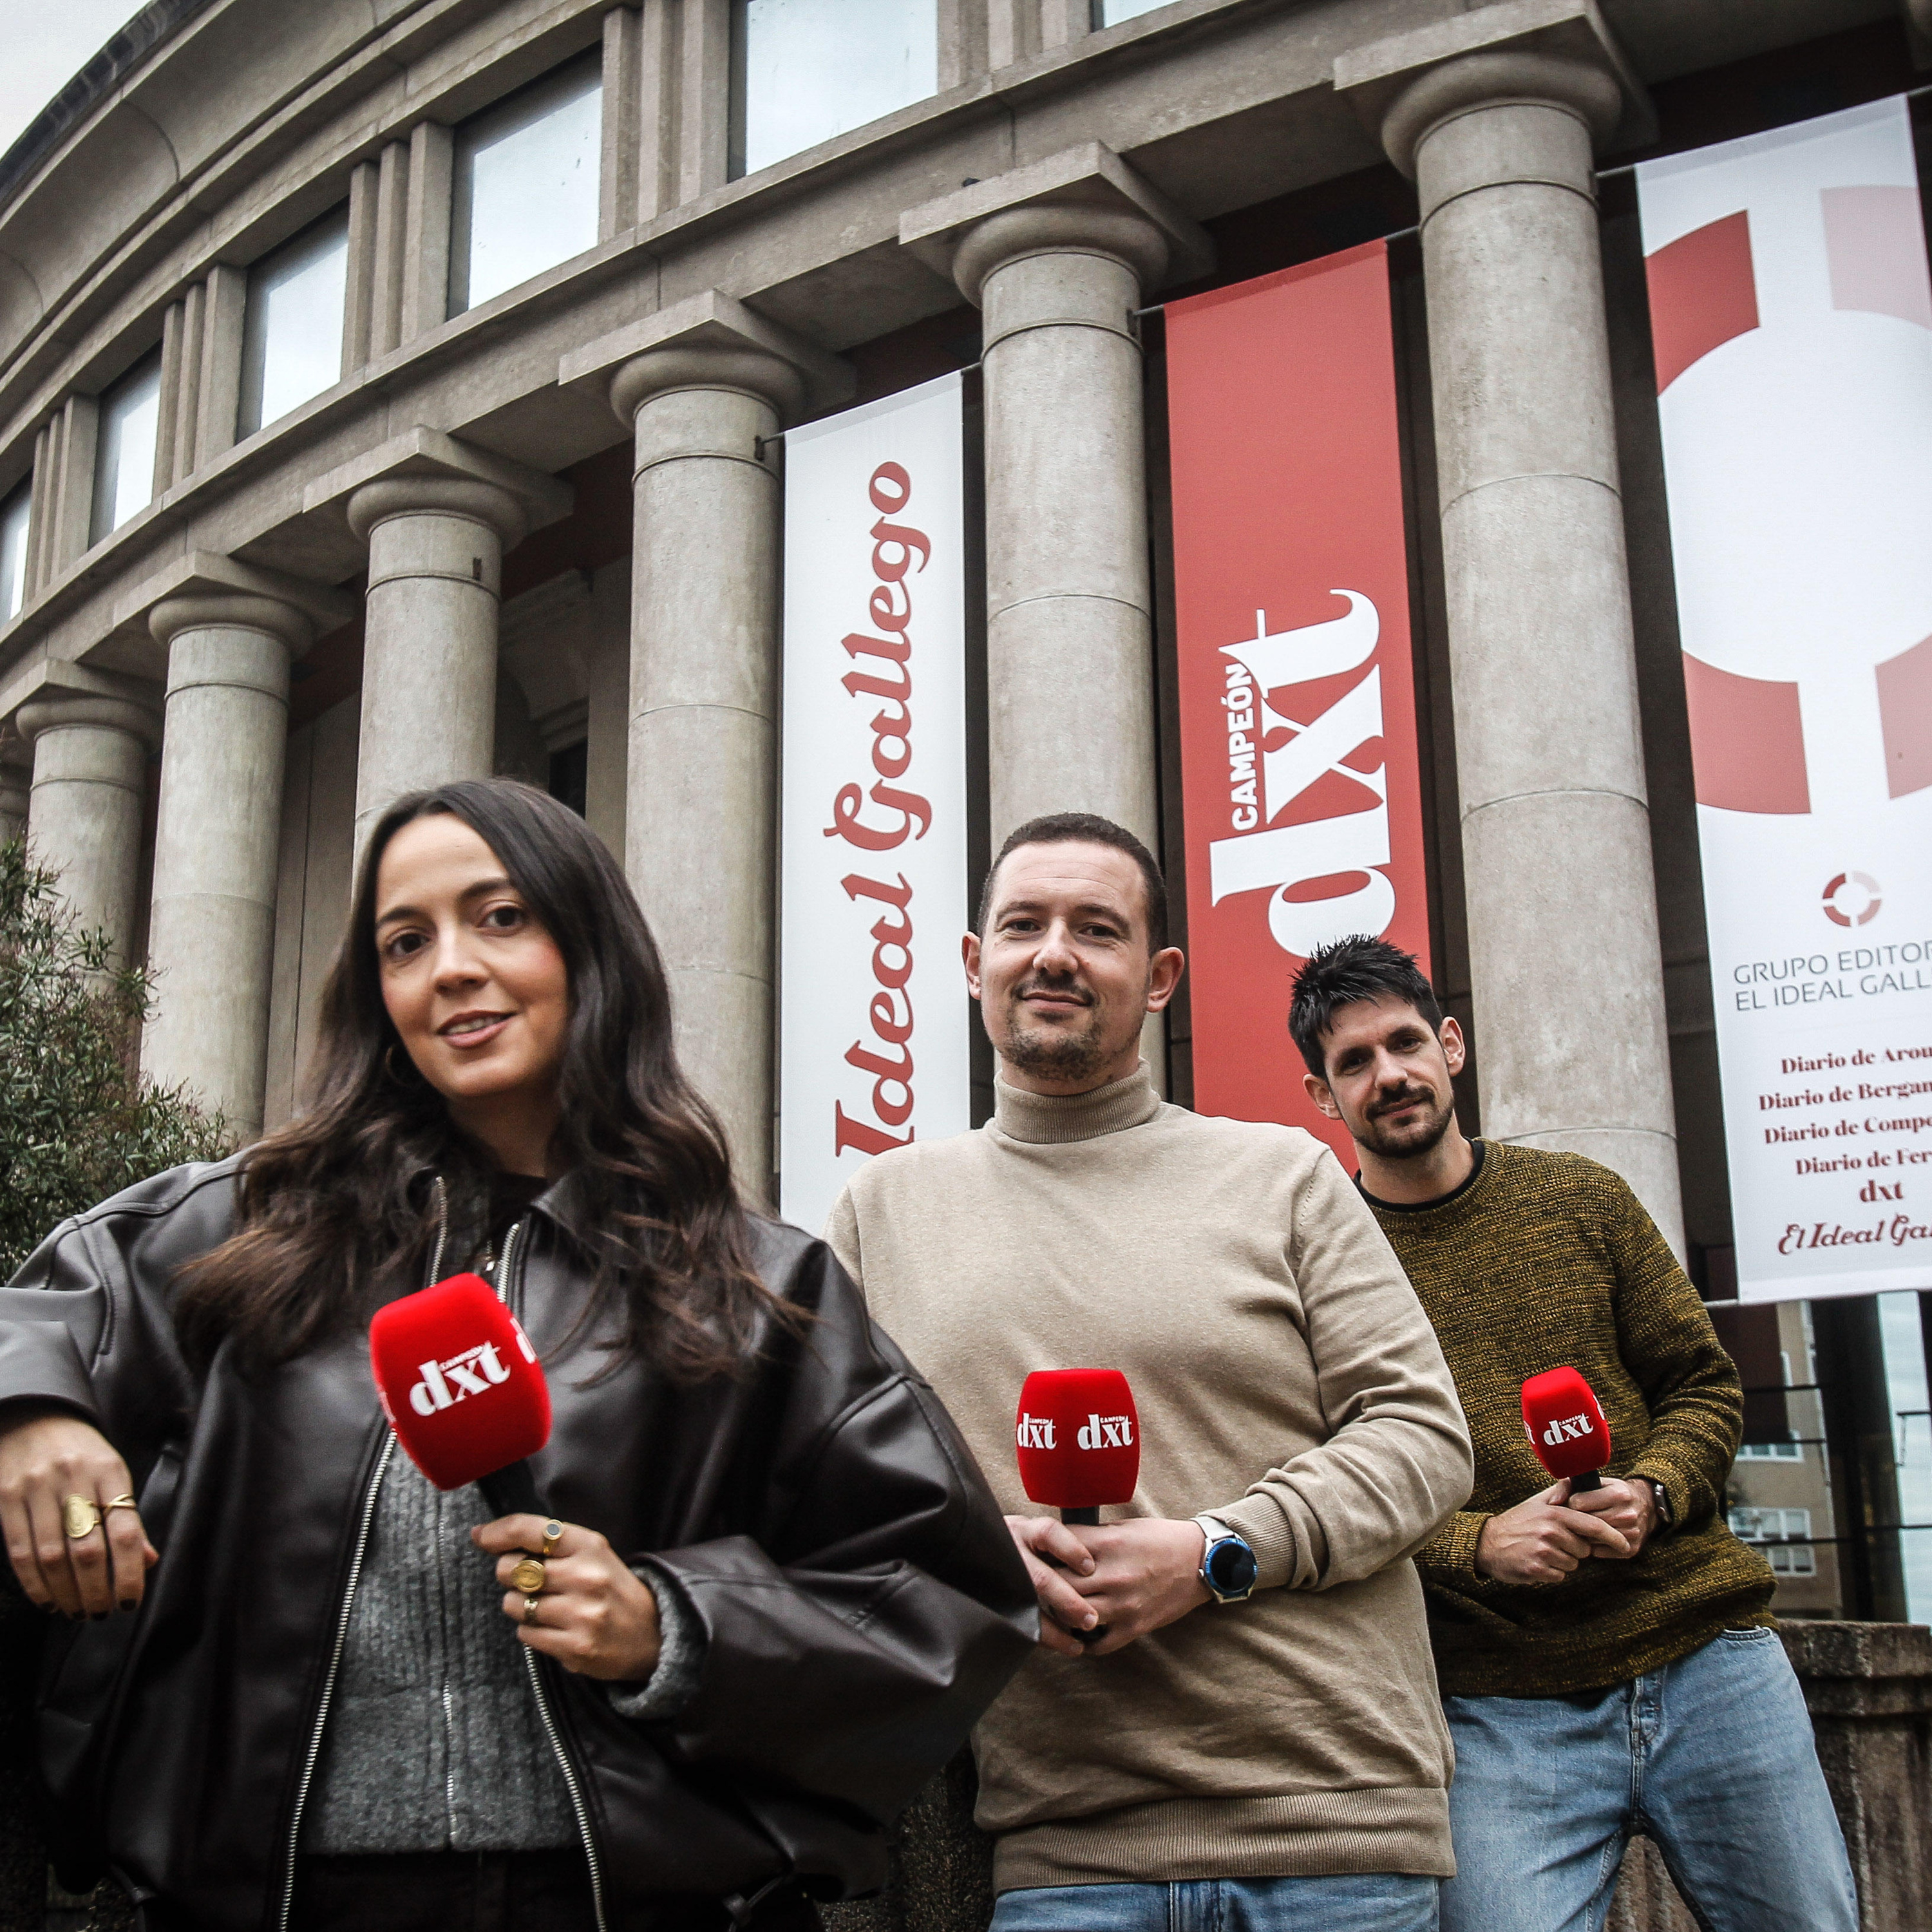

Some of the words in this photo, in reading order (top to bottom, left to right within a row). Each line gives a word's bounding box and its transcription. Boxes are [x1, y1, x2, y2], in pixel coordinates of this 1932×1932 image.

[824, 461, 932, 851] Gallego
[1220, 663, 1259, 831] CAMPEÓN
[1209, 589, 1396, 959] dxt
[1734, 954, 1828, 985] GRUPO
[835, 871, 914, 1156] Ideal
[1735, 990, 1766, 1012] EL
[1774, 980, 1853, 1006] IDEAL
[1781, 1052, 1847, 1075] Diario
[1851, 1048, 1876, 1066] de
[1759, 1088, 1824, 1112] Diario
[1828, 1085, 1853, 1103] de
[1764, 1122, 1830, 1145] Diario
[1834, 1119, 1859, 1137] de
[1795, 1153, 1862, 1176] Diario
[1866, 1150, 1892, 1168] de
[1859, 1179, 1905, 1204] dxt
[1776, 1222, 1806, 1256] El
[1806, 1219, 1886, 1249] Ideal
[1889, 1213, 1932, 1247] Ga
[409, 1340, 511, 1416] dxt
[1016, 1412, 1057, 1450] dxt
[1077, 1414, 1133, 1450] dxt
[1543, 1412, 1594, 1446] dxt
